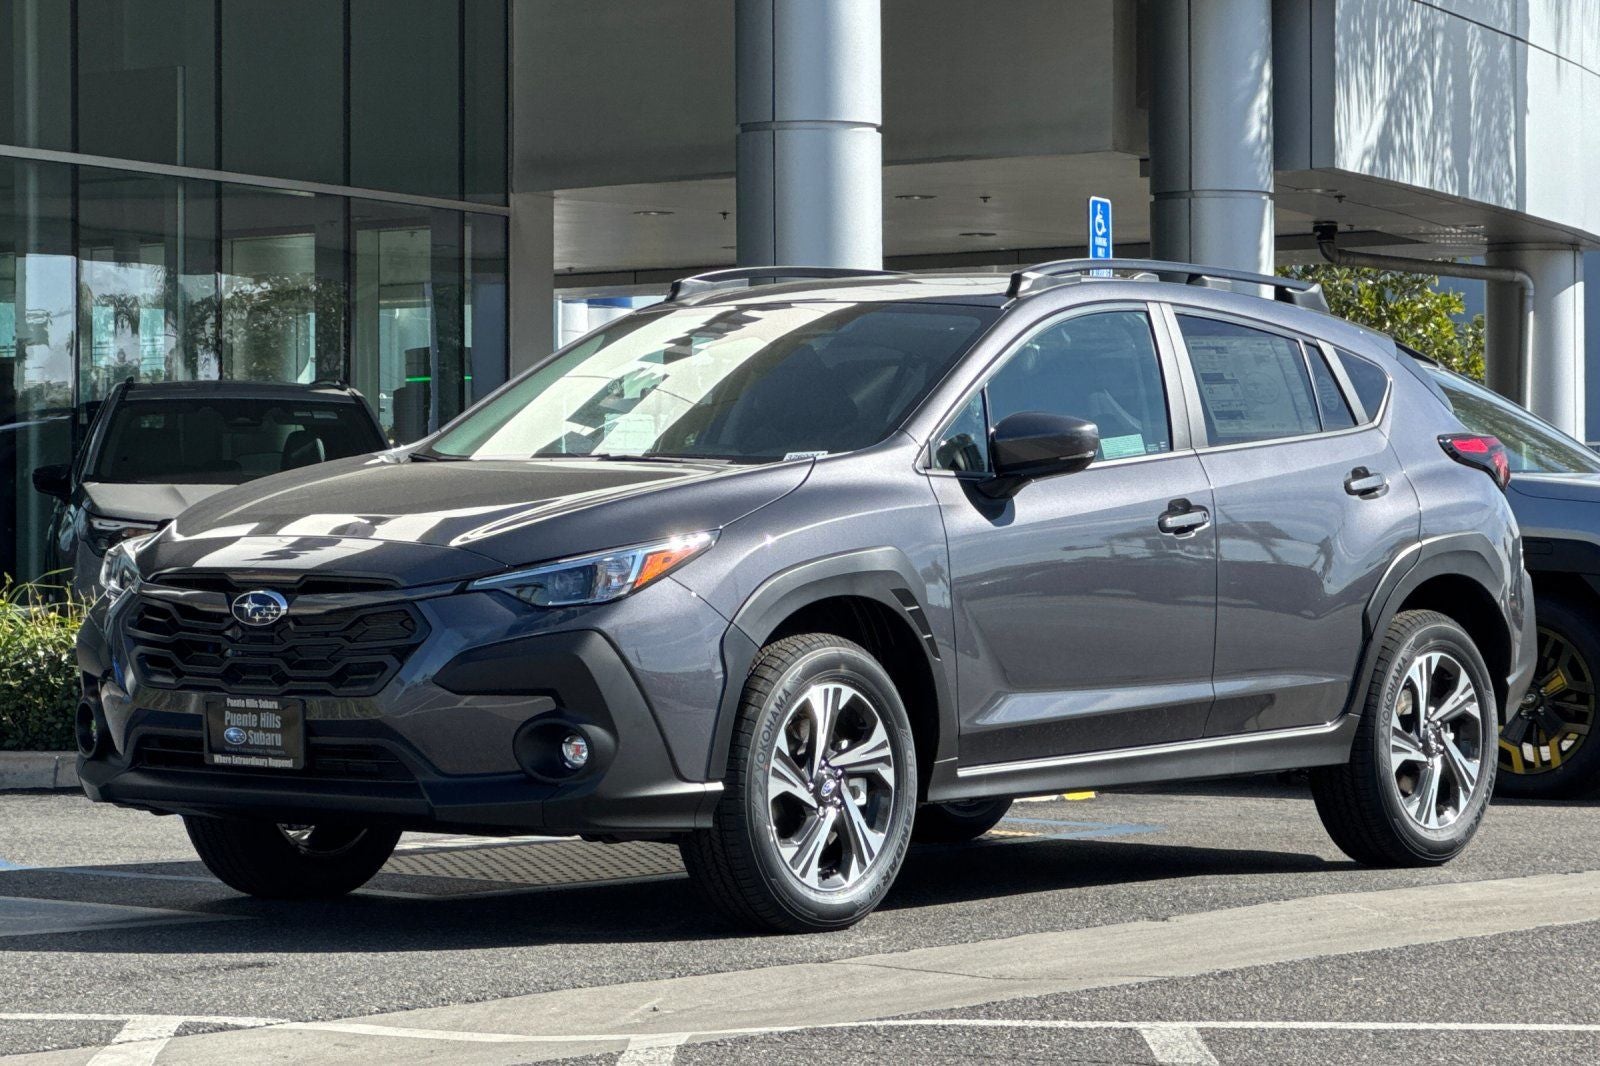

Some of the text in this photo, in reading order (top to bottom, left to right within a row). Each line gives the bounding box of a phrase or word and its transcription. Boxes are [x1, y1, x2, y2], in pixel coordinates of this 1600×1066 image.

[1381, 656, 1408, 728] YOKOHAMA
[226, 698, 278, 709] Puente Hills Subaru
[225, 711, 281, 728] Puente Hills
[248, 730, 281, 746] Subaru
[755, 688, 792, 772] YOKOHAMA
[213, 754, 231, 764] Where
[232, 755, 268, 767] Extraordinary
